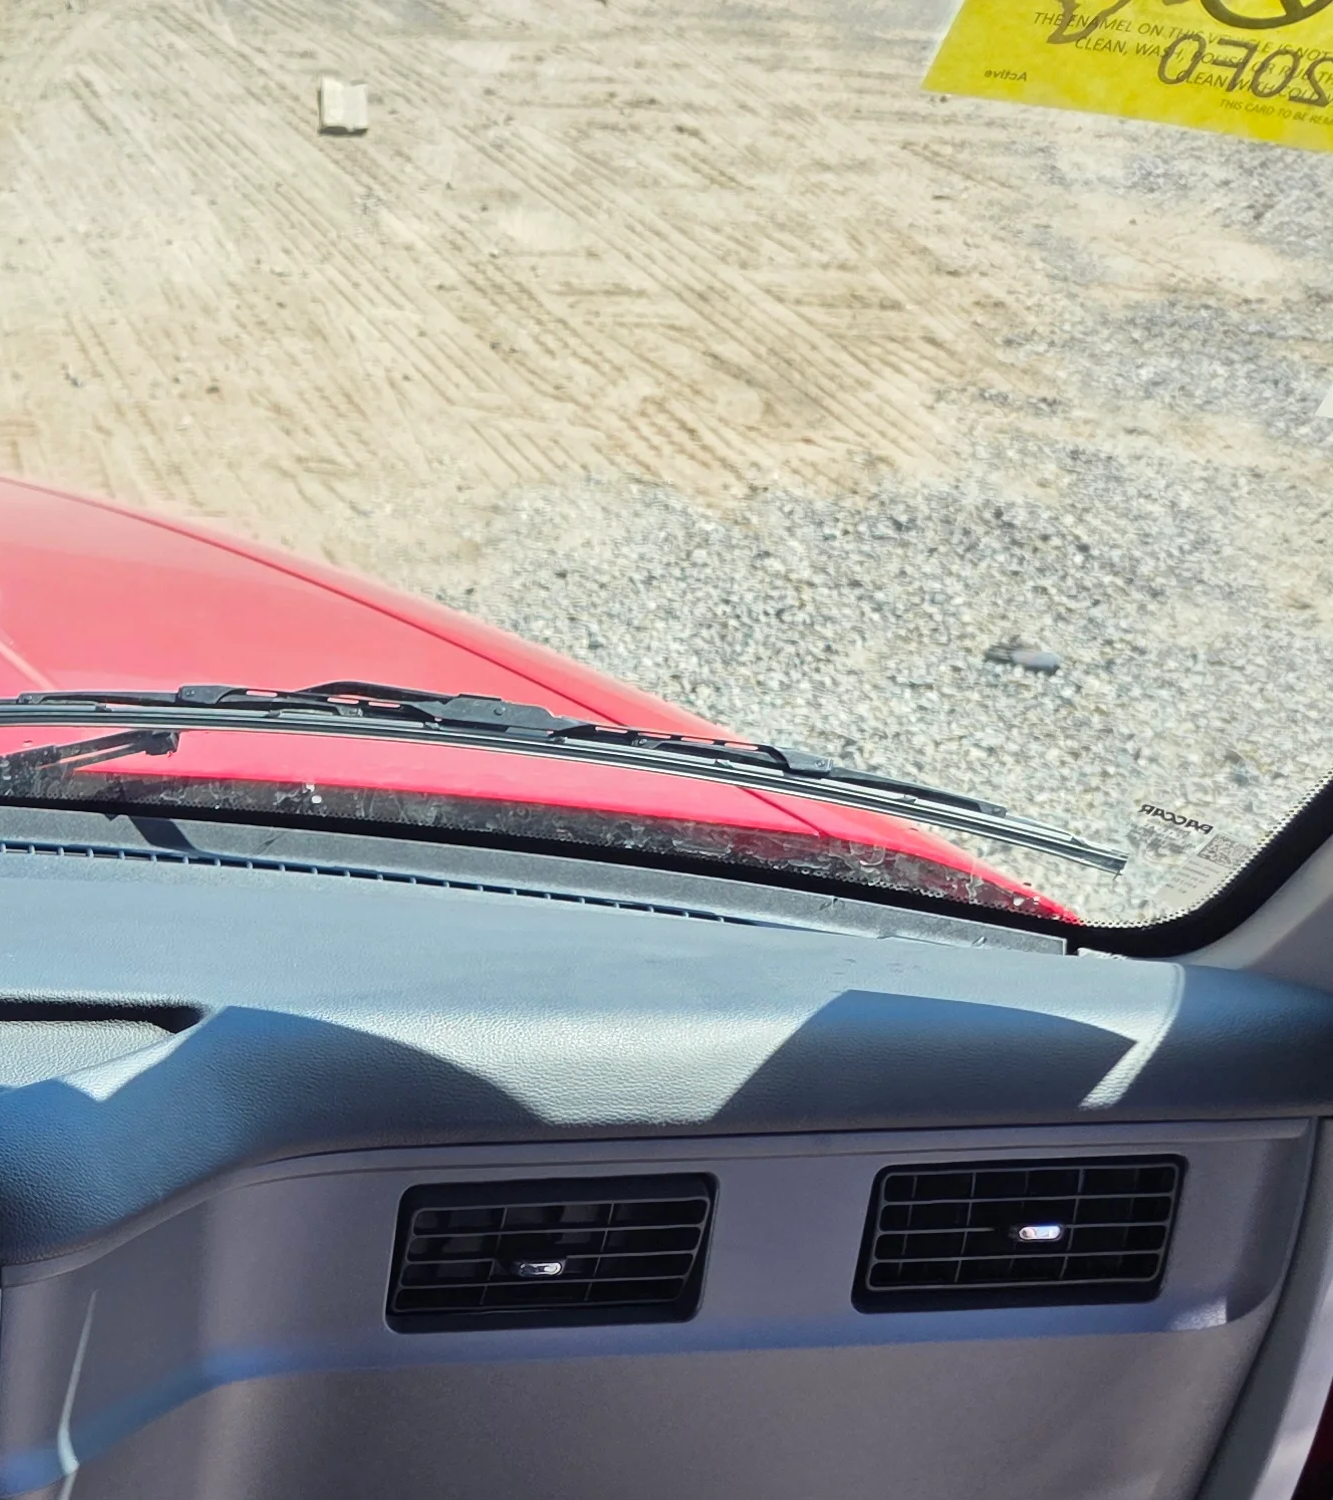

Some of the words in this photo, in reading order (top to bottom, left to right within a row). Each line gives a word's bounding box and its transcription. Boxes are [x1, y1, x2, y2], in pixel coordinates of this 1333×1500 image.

[1033, 12, 1065, 26] THE
[1137, 22, 1164, 37] ON
[1075, 37, 1128, 56] CLEAN,
